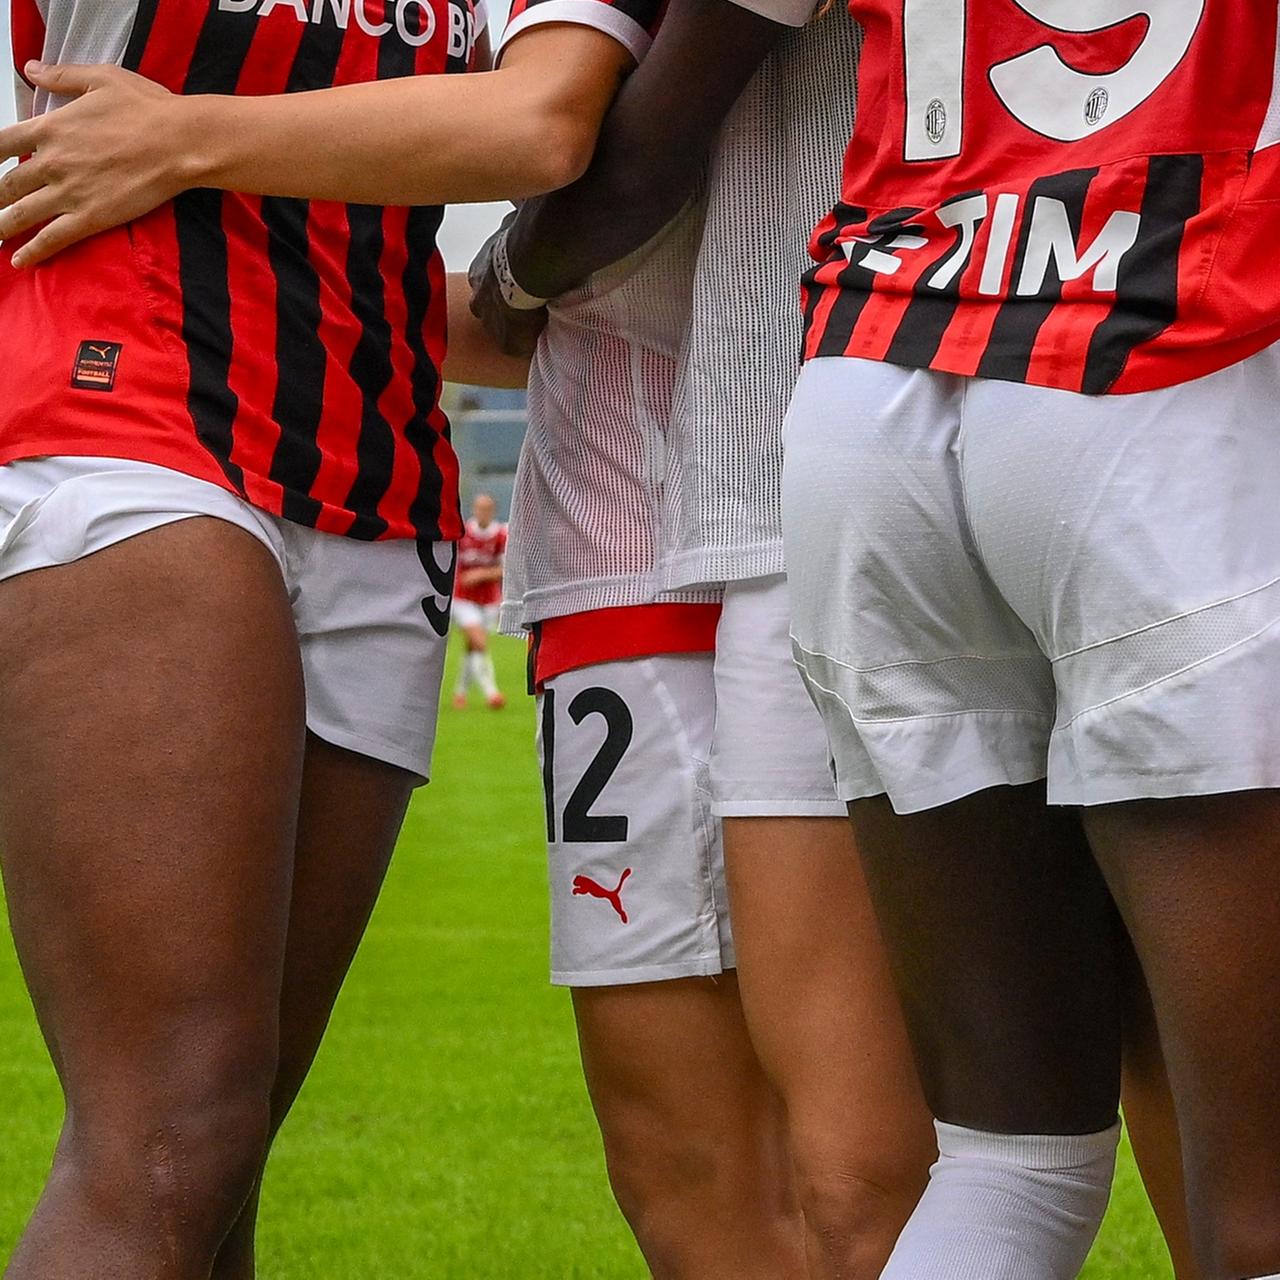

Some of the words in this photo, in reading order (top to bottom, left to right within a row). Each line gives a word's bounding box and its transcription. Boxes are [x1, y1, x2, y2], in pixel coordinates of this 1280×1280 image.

[447, 2, 476, 65] BP
[927, 193, 1141, 296] TIM
[541, 686, 634, 843] 12
